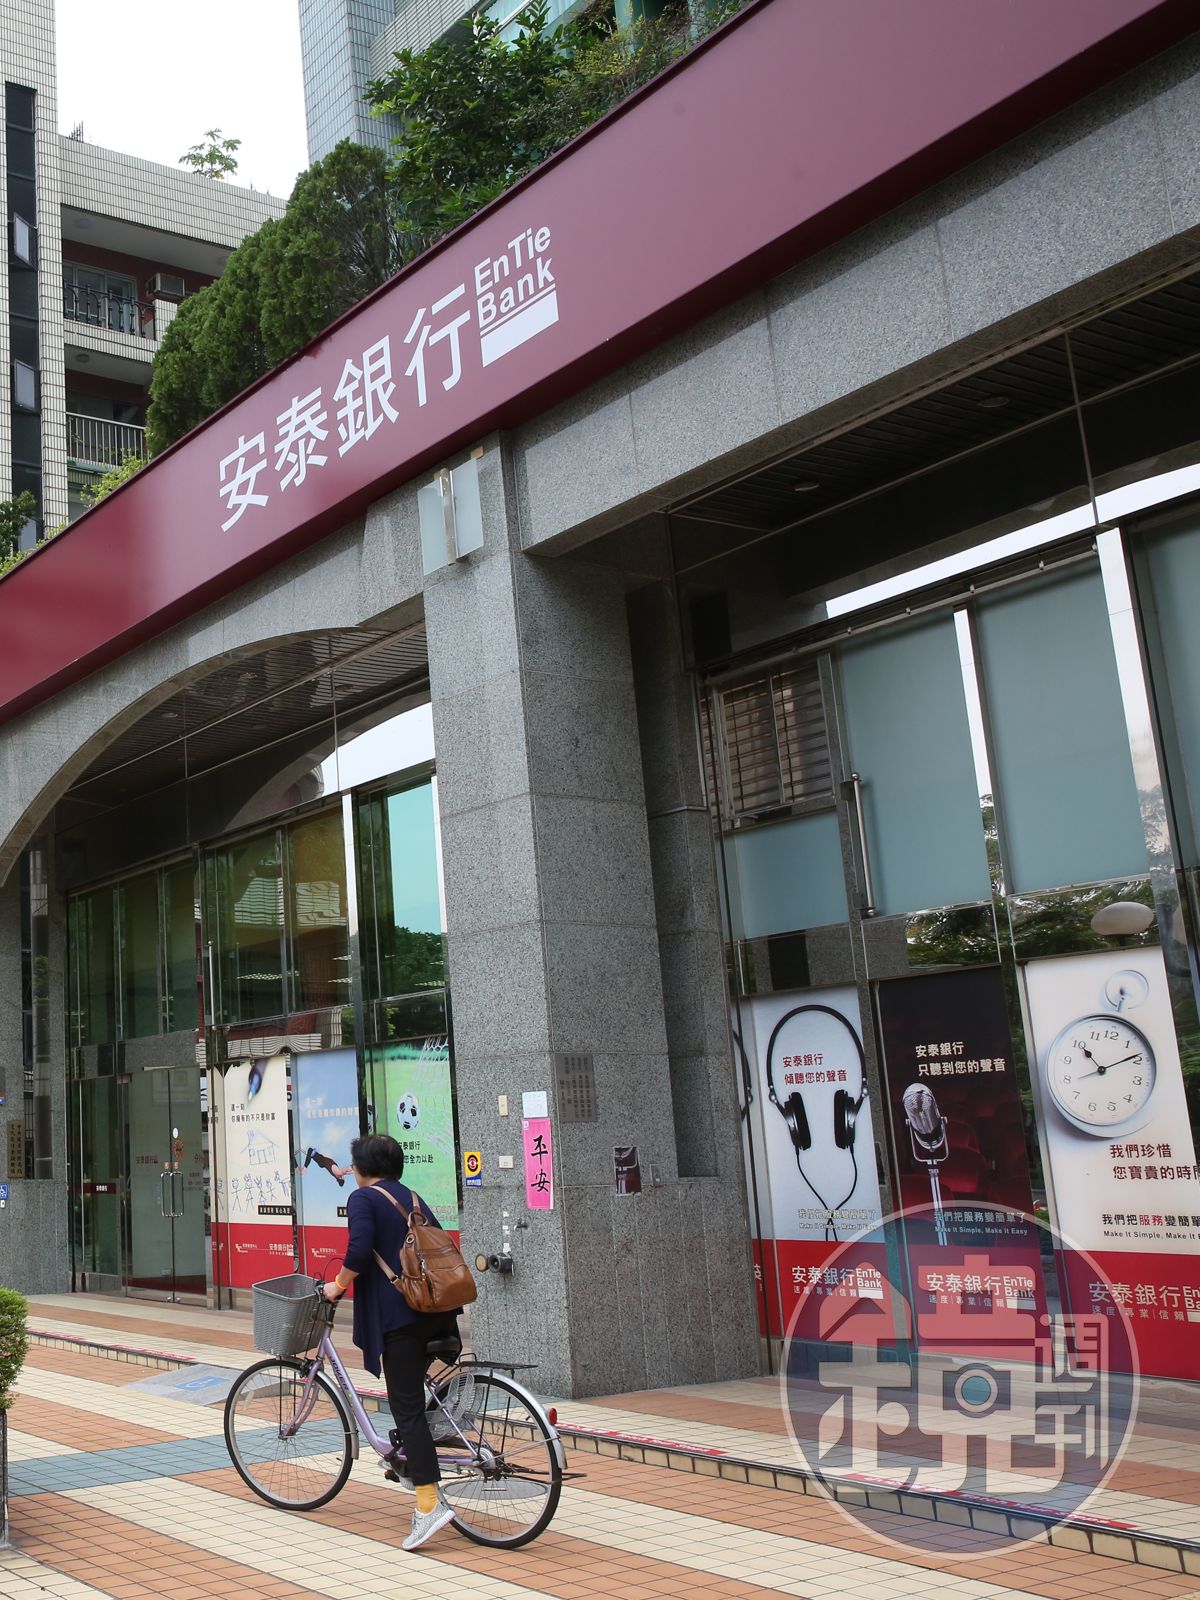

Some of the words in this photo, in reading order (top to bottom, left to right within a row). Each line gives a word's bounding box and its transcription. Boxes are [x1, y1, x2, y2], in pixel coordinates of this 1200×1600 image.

[474, 226, 551, 296] EnTie
[477, 258, 555, 328] Bank
[219, 283, 470, 532] 安泰銀行
[1090, 1031, 1100, 1041] 11
[1104, 1030, 1119, 1040] 12
[915, 1041, 964, 1058] 安泰銀行
[1072, 1040, 1086, 1049] 10
[1125, 1040, 1131, 1049] 1
[782, 1054, 823, 1068] 安泰銀行
[1064, 1056, 1072, 1064] 9
[1133, 1055, 1142, 1065] 2
[918, 1058, 1005, 1076] 只聽到您的聲音
[784, 1069, 847, 1085] 傾聽您的聲音
[1063, 1075, 1071, 1084] 8
[1133, 1076, 1142, 1086] 3
[1073, 1091, 1081, 1100] 7
[1123, 1094, 1133, 1103] 4
[1088, 1103, 1097, 1112] 6
[1107, 1102, 1116, 1112] 5
[1110, 1144, 1172, 1158] 我們珍惜
[531, 1134, 550, 1192] 平安
[934, 1211, 1025, 1222] 我們把服務變簡單了
[960, 1226, 983, 1235] Simple,
[1011, 1228, 1028, 1236] Easy
[1133, 1231, 1164, 1239] Simple,
[791, 1265, 855, 1286] 安泰銀行
[856, 1268, 881, 1279] EnTie
[857, 1278, 882, 1288] Bank
[927, 1273, 1001, 1296] 安泰銀行
[1003, 1276, 1033, 1287] EnTie
[1004, 1286, 1034, 1298] Bank
[1089, 1281, 1181, 1308] 安泰銀行
[1184, 1298, 1200, 1310] Ba
